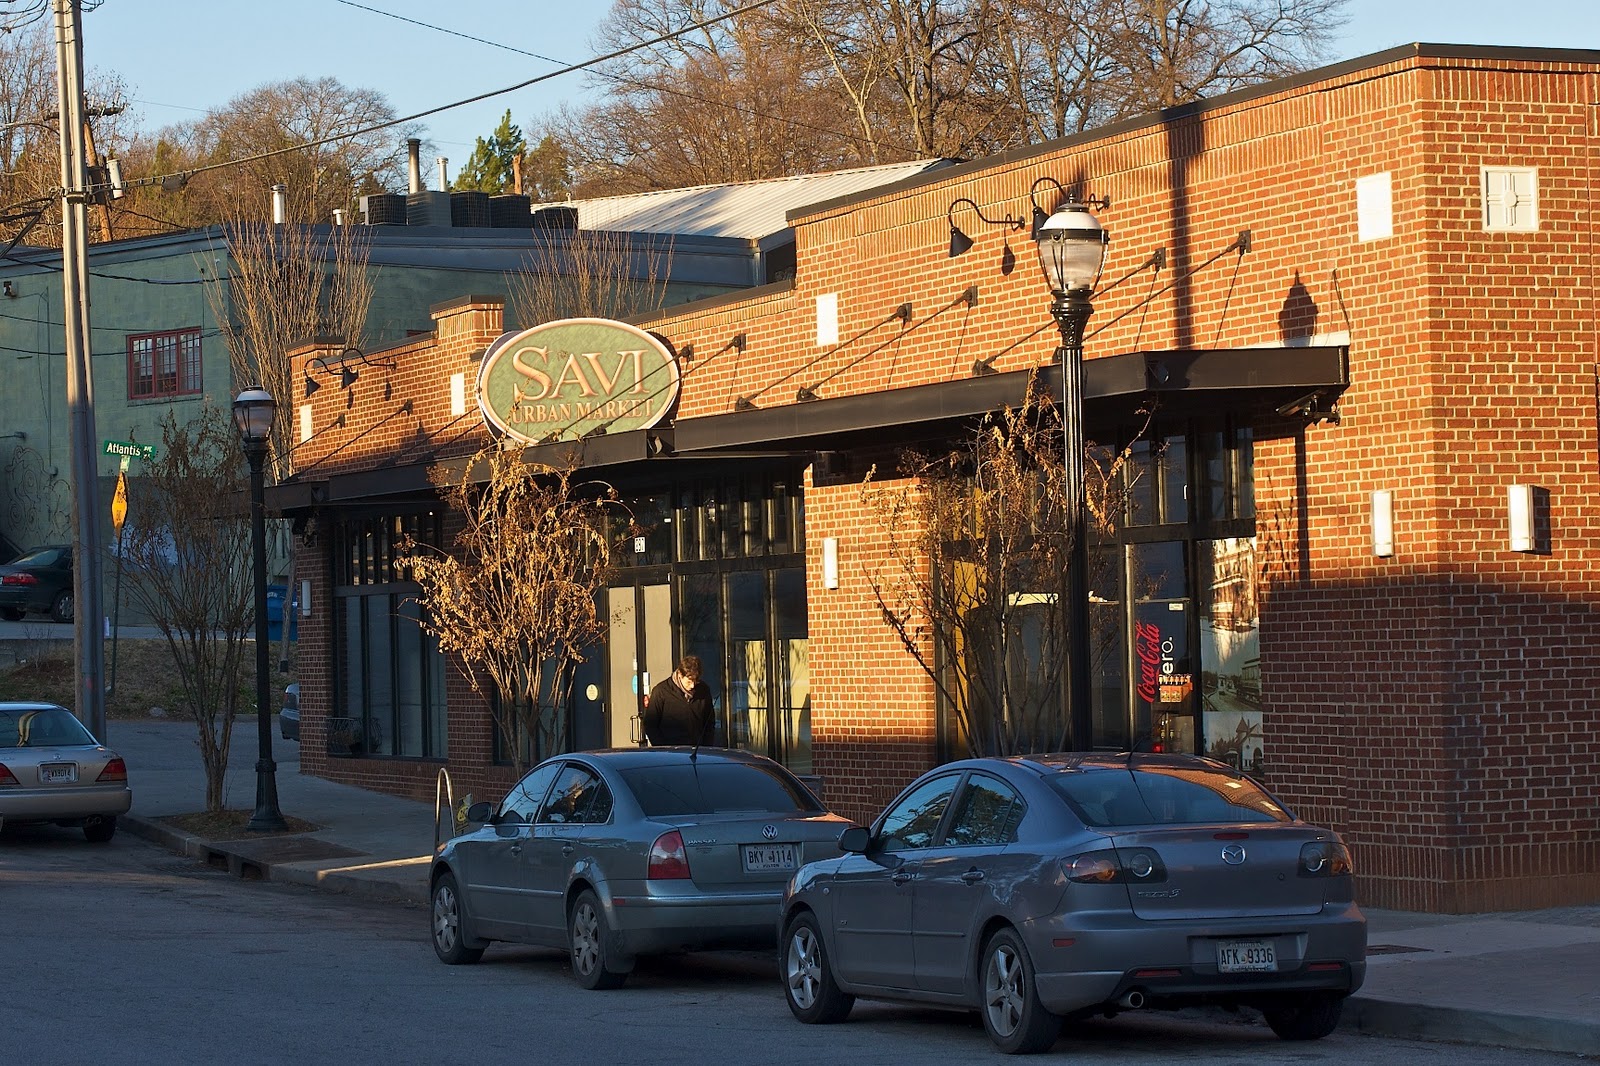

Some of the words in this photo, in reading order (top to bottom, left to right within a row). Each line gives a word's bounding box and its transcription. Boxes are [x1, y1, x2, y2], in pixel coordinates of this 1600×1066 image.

[512, 345, 650, 401] SAVI
[512, 403, 572, 424] URBAN
[577, 398, 654, 420] MARKET
[106, 442, 141, 456] Atlantis
[748, 850, 765, 864] BKY
[771, 850, 792, 863] 1114
[1221, 948, 1240, 965] AFK
[1247, 947, 1274, 964] 9336
